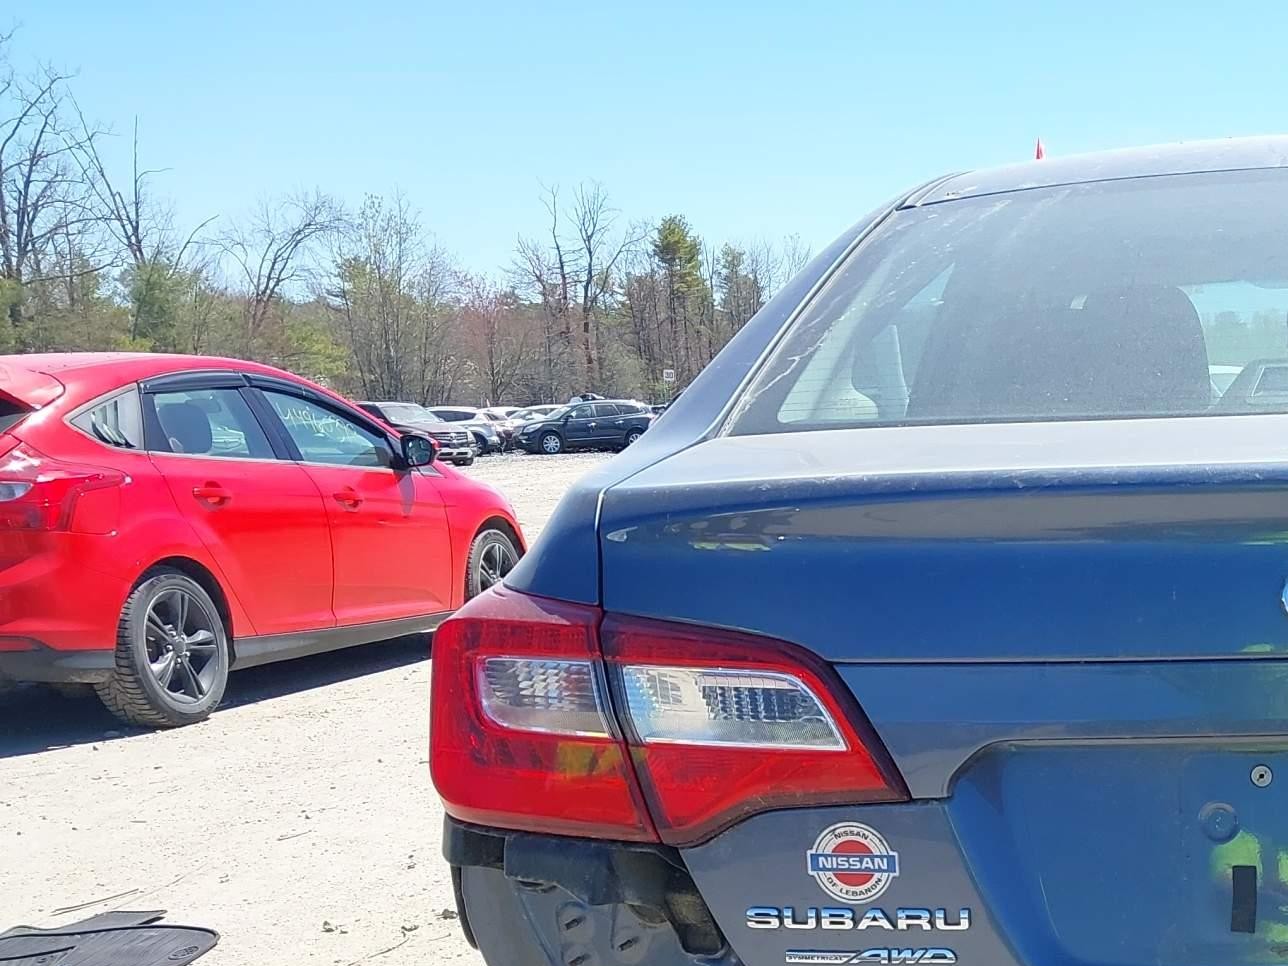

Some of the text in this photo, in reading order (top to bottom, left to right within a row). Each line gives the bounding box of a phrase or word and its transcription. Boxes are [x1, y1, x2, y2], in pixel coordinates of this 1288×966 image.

[834, 830, 870, 841] NISSAN
[818, 856, 888, 870] NISSAN
[826, 876, 883, 897] OF LEBANON
[746, 906, 972, 931] SUBARU
[848, 947, 958, 964] AWD
